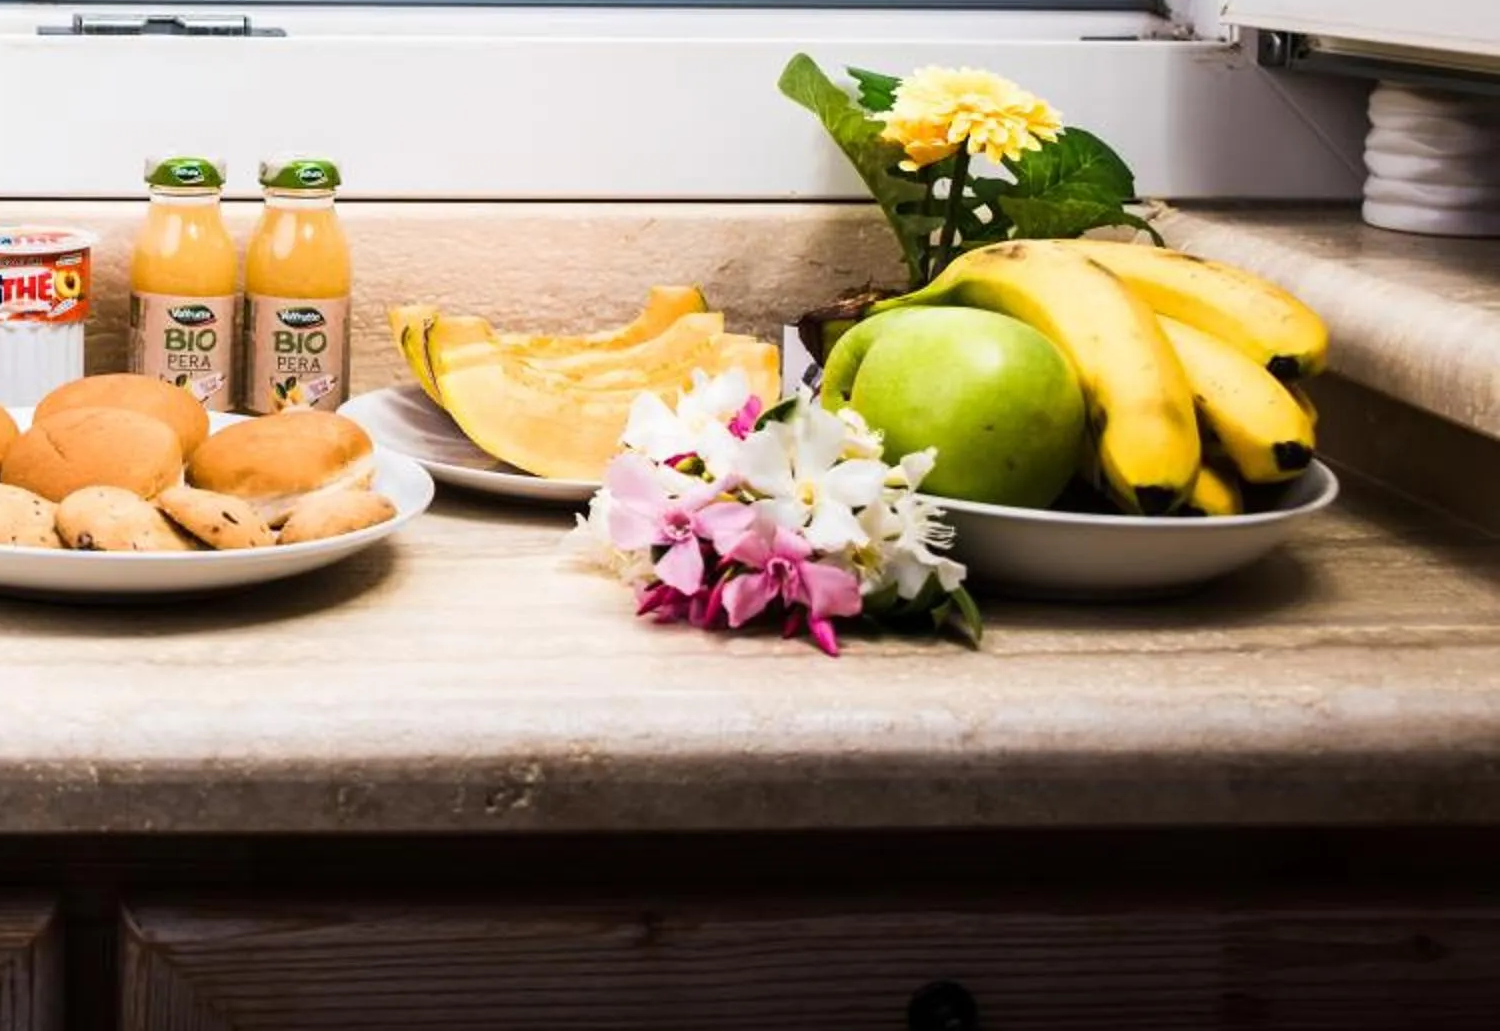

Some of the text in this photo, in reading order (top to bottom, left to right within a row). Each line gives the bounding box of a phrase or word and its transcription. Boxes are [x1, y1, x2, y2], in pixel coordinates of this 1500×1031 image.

[164, 328, 217, 351] BIO
[273, 330, 327, 354] BIO
[167, 354, 212, 369] PERA
[277, 356, 321, 372] PERA
